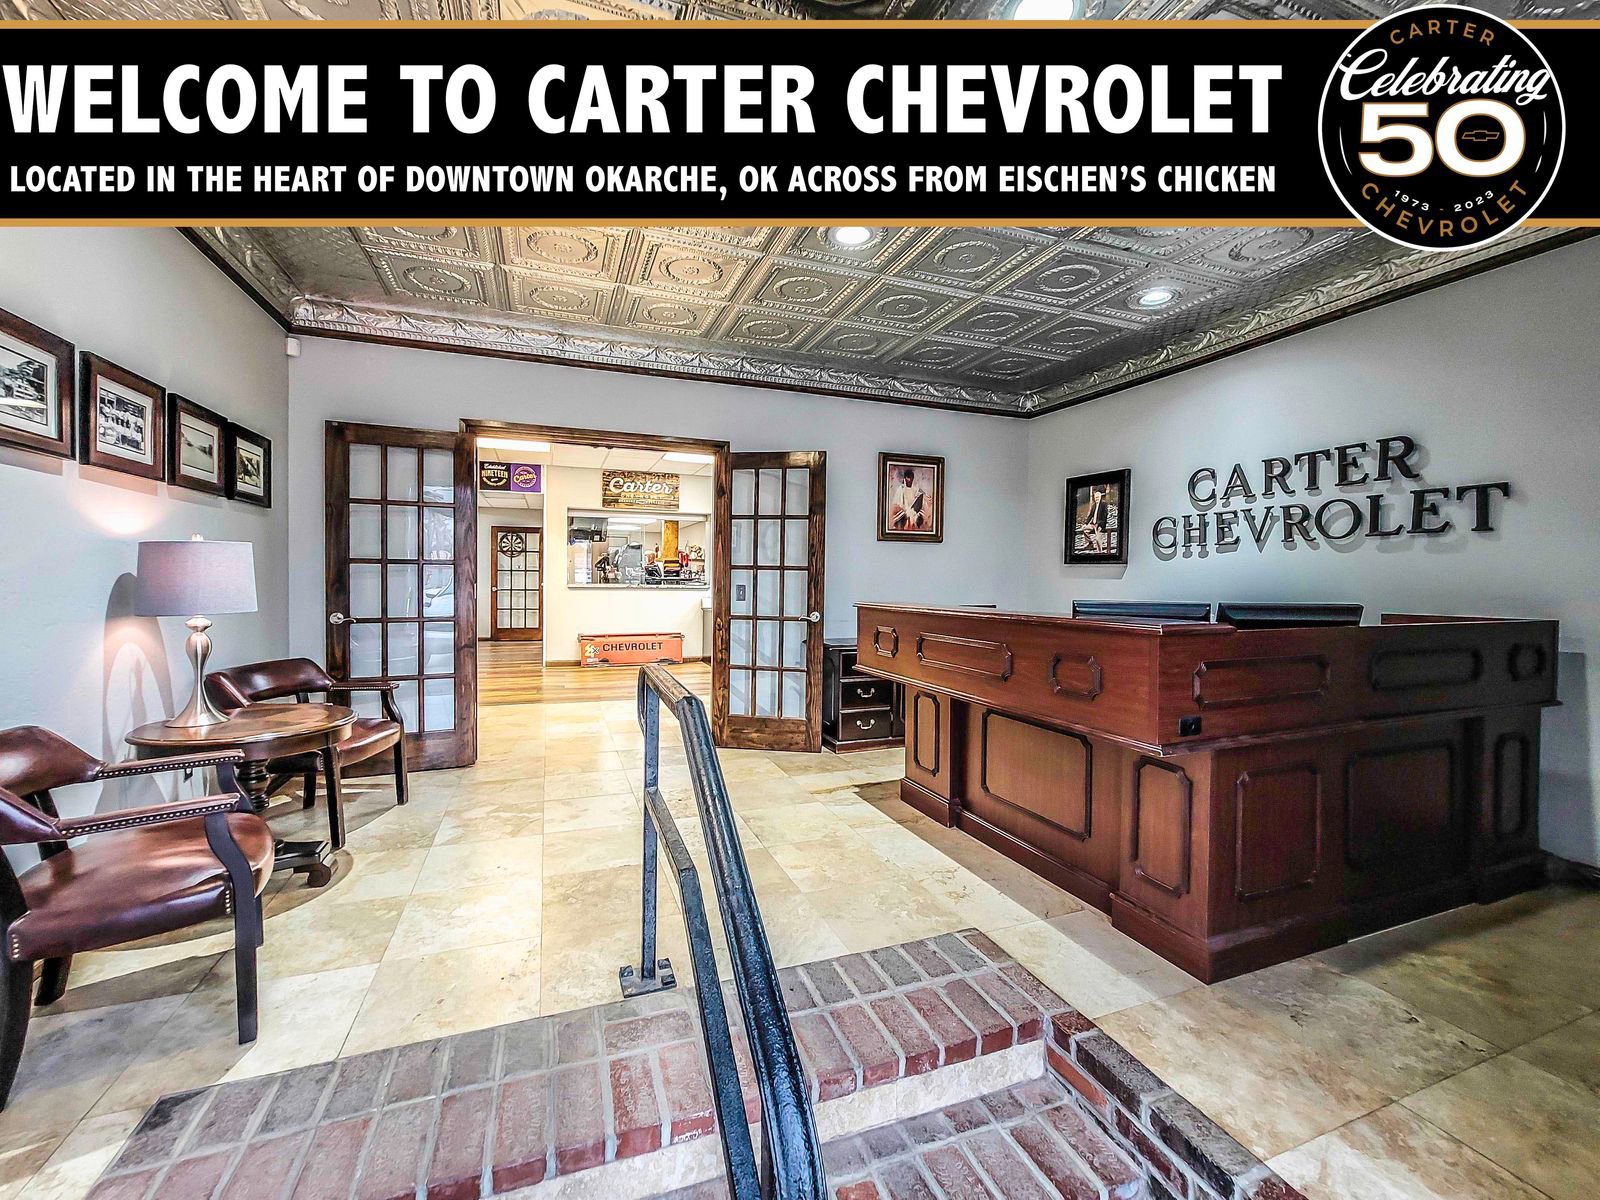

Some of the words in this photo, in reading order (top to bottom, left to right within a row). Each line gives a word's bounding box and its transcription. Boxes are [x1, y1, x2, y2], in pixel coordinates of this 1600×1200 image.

[609, 477, 673, 494] Carter
[1187, 435, 1421, 503] CARTER
[1152, 481, 1511, 549] CHEVROLET
[602, 641, 663, 652] CHEVROLET
